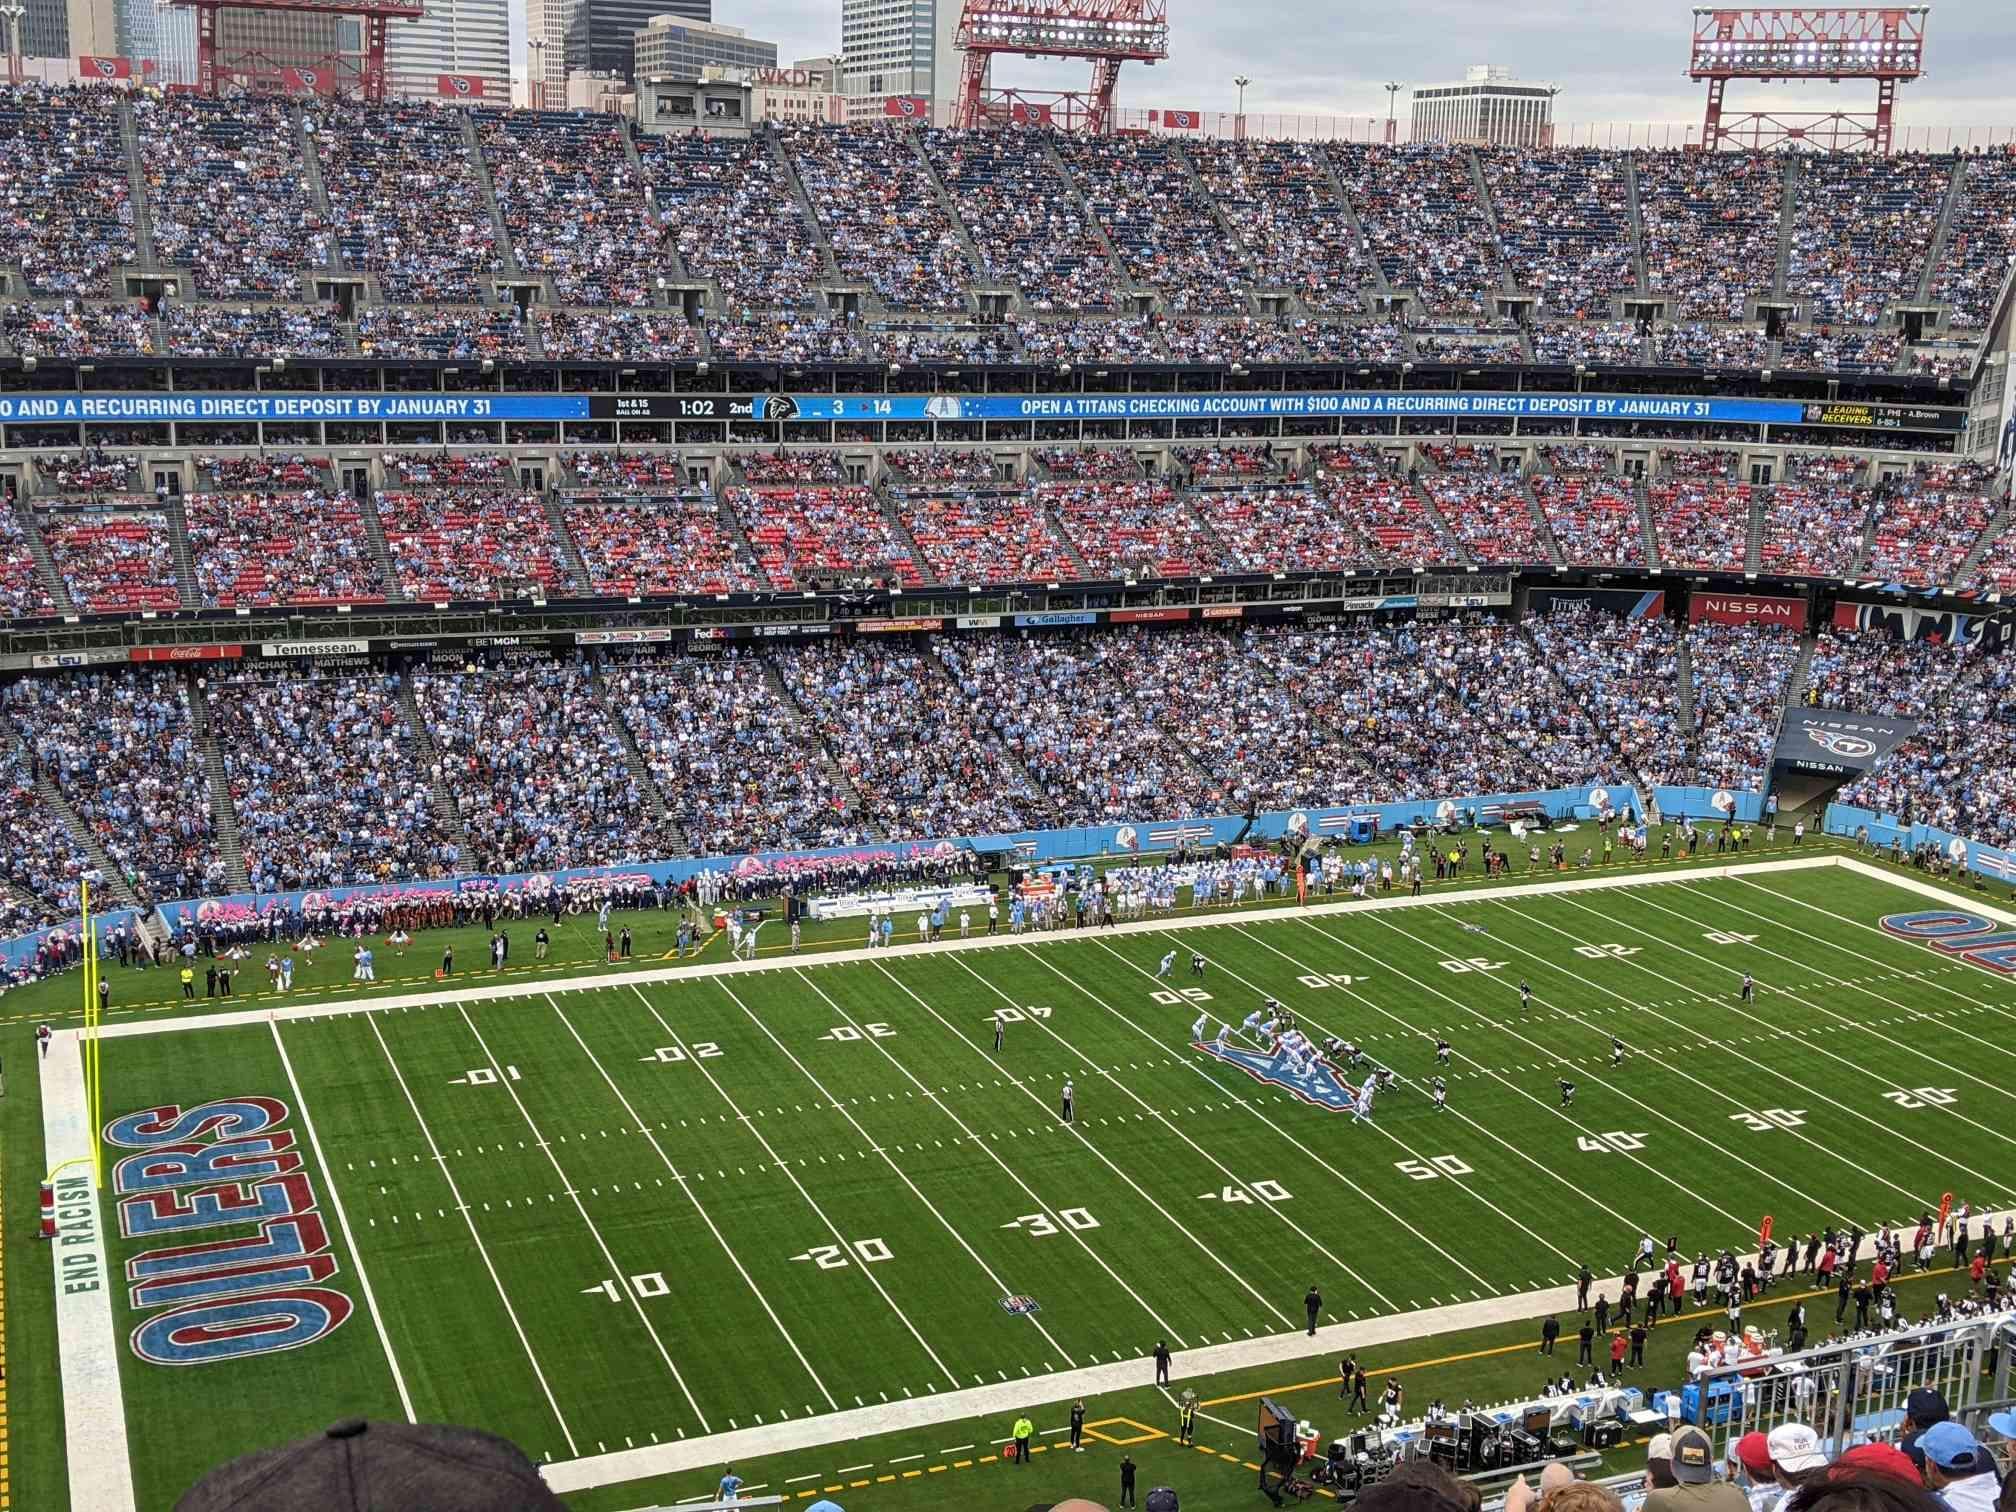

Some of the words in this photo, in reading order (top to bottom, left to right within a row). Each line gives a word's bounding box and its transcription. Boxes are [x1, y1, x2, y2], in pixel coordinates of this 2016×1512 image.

[758, 67, 823, 87] WKDF
[18, 400, 58, 415] AND
[63, 400, 77, 415] A
[82, 399, 196, 415] RECURRING
[202, 399, 269, 415] DIRECT
[275, 399, 352, 415] DEPOSIT
[358, 399, 380, 415] BY
[386, 399, 468, 415] JANUARY
[473, 399, 490, 414] 31
[617, 399, 630, 407] 1st
[631, 399, 638, 407] &
[639, 399, 649, 407] 15
[680, 400, 714, 415] 1:02
[729, 402, 752, 414] 2nd
[833, 400, 844, 414] 3
[873, 400, 891, 414] 14
[1021, 400, 1060, 415] OPEN
[1063, 400, 1073, 414] A
[1076, 399, 1126, 413] TITANS
[1129, 399, 1200, 413] CHECKING
[1203, 398, 1266, 413] ACCOUNT
[1270, 398, 1302, 411] WITH
[1307, 397, 1338, 411] $100
[1341, 397, 1370, 410] AND
[1373, 398, 1383, 410] A
[1387, 397, 1469, 411] RECURRING
[1472, 397, 1527, 411] DIRECT
[1530, 398, 1593, 413] DEPOSIT
[1597, 399, 1616, 414] BY
[1619, 399, 1690, 415] JANUARY
[1694, 402, 1711, 416] 31
[1827, 405, 1869, 415] LEADING
[1821, 413, 1873, 425] RECEIVERS
[1909, 411, 1940, 419] A.Brown
[1550, 597, 1592, 612] TITANS
[1705, 599, 1792, 617] NISSAN
[1042, 614, 1085, 625] Gallagher
[694, 627, 724, 640] FedEx
[53, 655, 81, 665] tsu
[432, 653, 464, 663] MOON
[1802, 719, 1894, 735] NISSAN
[1796, 760, 1844, 773] NISSAN
[1702, 931, 1754, 946] 10
[1573, 943, 1637, 959] 20
[1437, 957, 1502, 974] 30
[1296, 973, 1353, 989] 40
[1149, 987, 1214, 1005] 50
[994, 1005, 1053, 1024] 40
[830, 1022, 896, 1041] 30
[653, 1042, 725, 1063] 20
[465, 1065, 521, 1086] 10
[1881, 1086, 1959, 1110] 20
[1728, 1108, 1806, 1132] 30
[1577, 1130, 1646, 1154] 40
[1394, 1155, 1475, 1180] 50
[1220, 1179, 1294, 1206] 40
[56, 1176, 95, 1246] RACISM
[1017, 1207, 1101, 1237] 30
[102, 1096, 354, 1366] OILERS
[806, 1237, 894, 1270] 20
[63, 1253, 100, 1295] END
[600, 1271, 671, 1303] 10
